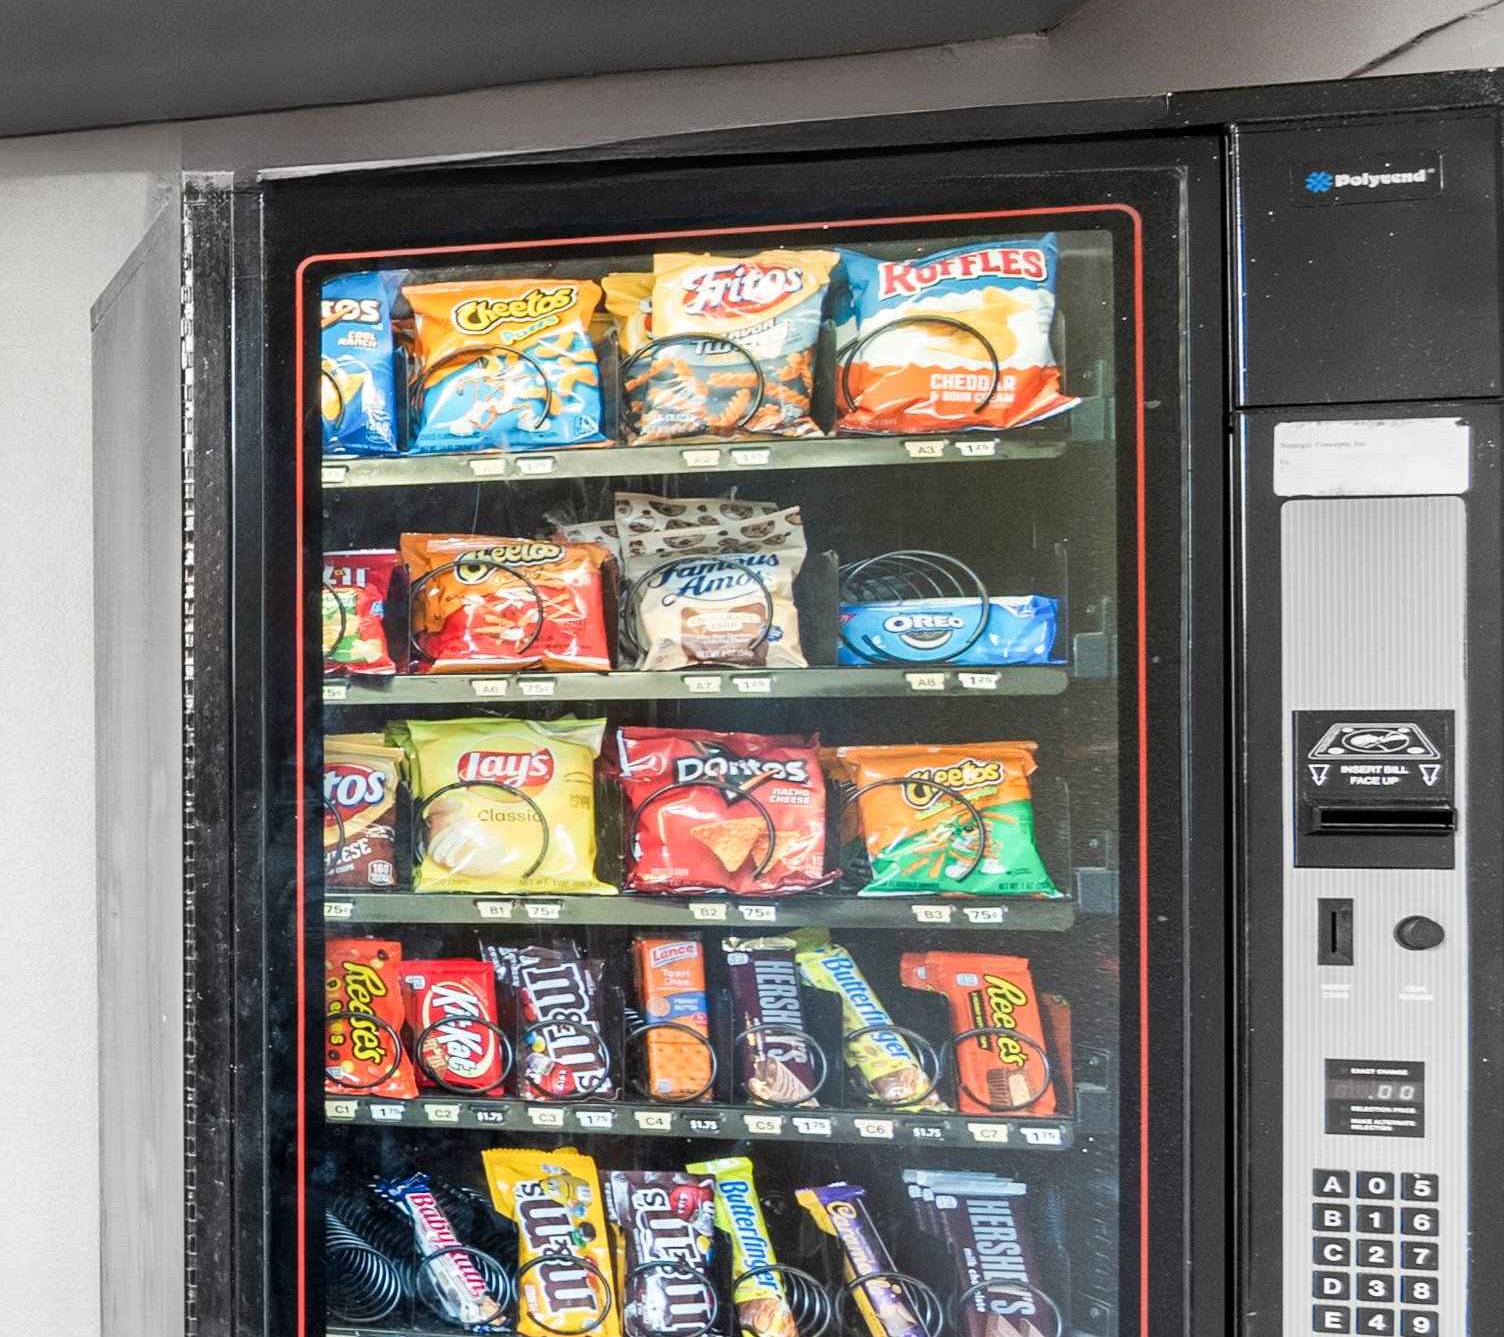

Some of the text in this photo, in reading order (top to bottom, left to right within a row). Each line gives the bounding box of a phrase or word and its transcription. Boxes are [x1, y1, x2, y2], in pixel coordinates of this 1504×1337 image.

[1335, 169, 1427, 189] Polyvend
[879, 248, 1047, 300] RUFFLES
[683, 262, 803, 316] Fritos
[452, 285, 578, 334] Cheetos
[942, 392, 971, 402] SOUR
[918, 445, 935, 454] A3
[883, 614, 965, 633] OREO
[918, 678, 935, 687] A8
[482, 685, 498, 694] A6
[460, 749, 550, 788] Lay's
[1340, 765, 1410, 774] INSERT BILL
[1350, 776, 1399, 785] FACE UP
[771, 788, 811, 796] NACHO
[769, 796, 811, 804] CHEESE
[478, 809, 540, 824] Classic
[489, 906, 504, 915] B1
[700, 908, 717, 917] B2
[924, 910, 942, 919] B3
[652, 943, 695, 962] Lance
[661, 969, 690, 978] Toast
[342, 962, 387, 1064] Reese's
[1350, 1067, 1408, 1076] EXACT CHANGE
[335, 1105, 349, 1114] C1
[435, 1109, 452, 1118] C2
[1350, 1105, 1391, 1113] SELECTION
[539, 1114, 556, 1123] C3
[1350, 1118, 1417, 1127] MAKE ALTERNATE
[646, 1117, 717, 1131] C4 $1.75
[756, 1121, 774, 1131] C5
[1350, 1124, 1393, 1132] SELECTION
[866, 1125, 941, 1138] C6 $1.75
[980, 1129, 998, 1138] C7
[1323, 1176, 1431, 1197] A 0 5
[1324, 1210, 1431, 1231] B 1 6
[1323, 1244, 1430, 1265] C 2 7
[1323, 1277, 1431, 1299] D 3 8
[1325, 1311, 1430, 1334] E 4 9
